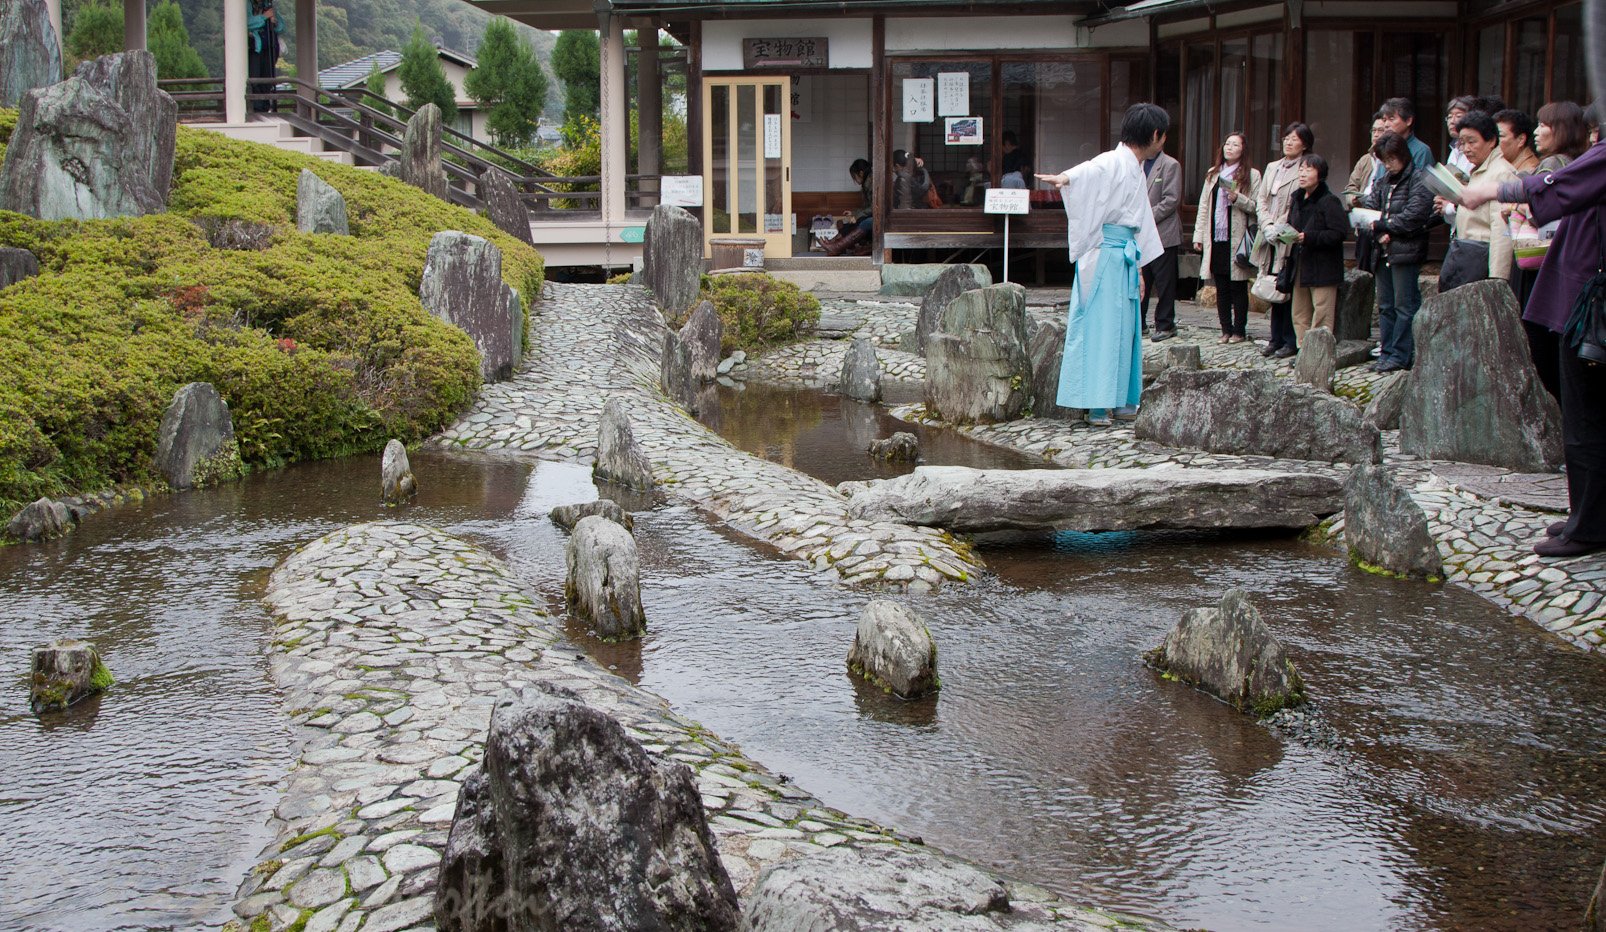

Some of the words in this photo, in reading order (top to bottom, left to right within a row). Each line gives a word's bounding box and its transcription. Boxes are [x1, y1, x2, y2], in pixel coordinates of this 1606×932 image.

[752, 40, 815, 57] 宝物館
[805, 57, 823, 65] 入口
[909, 95, 918, 115] 入口
